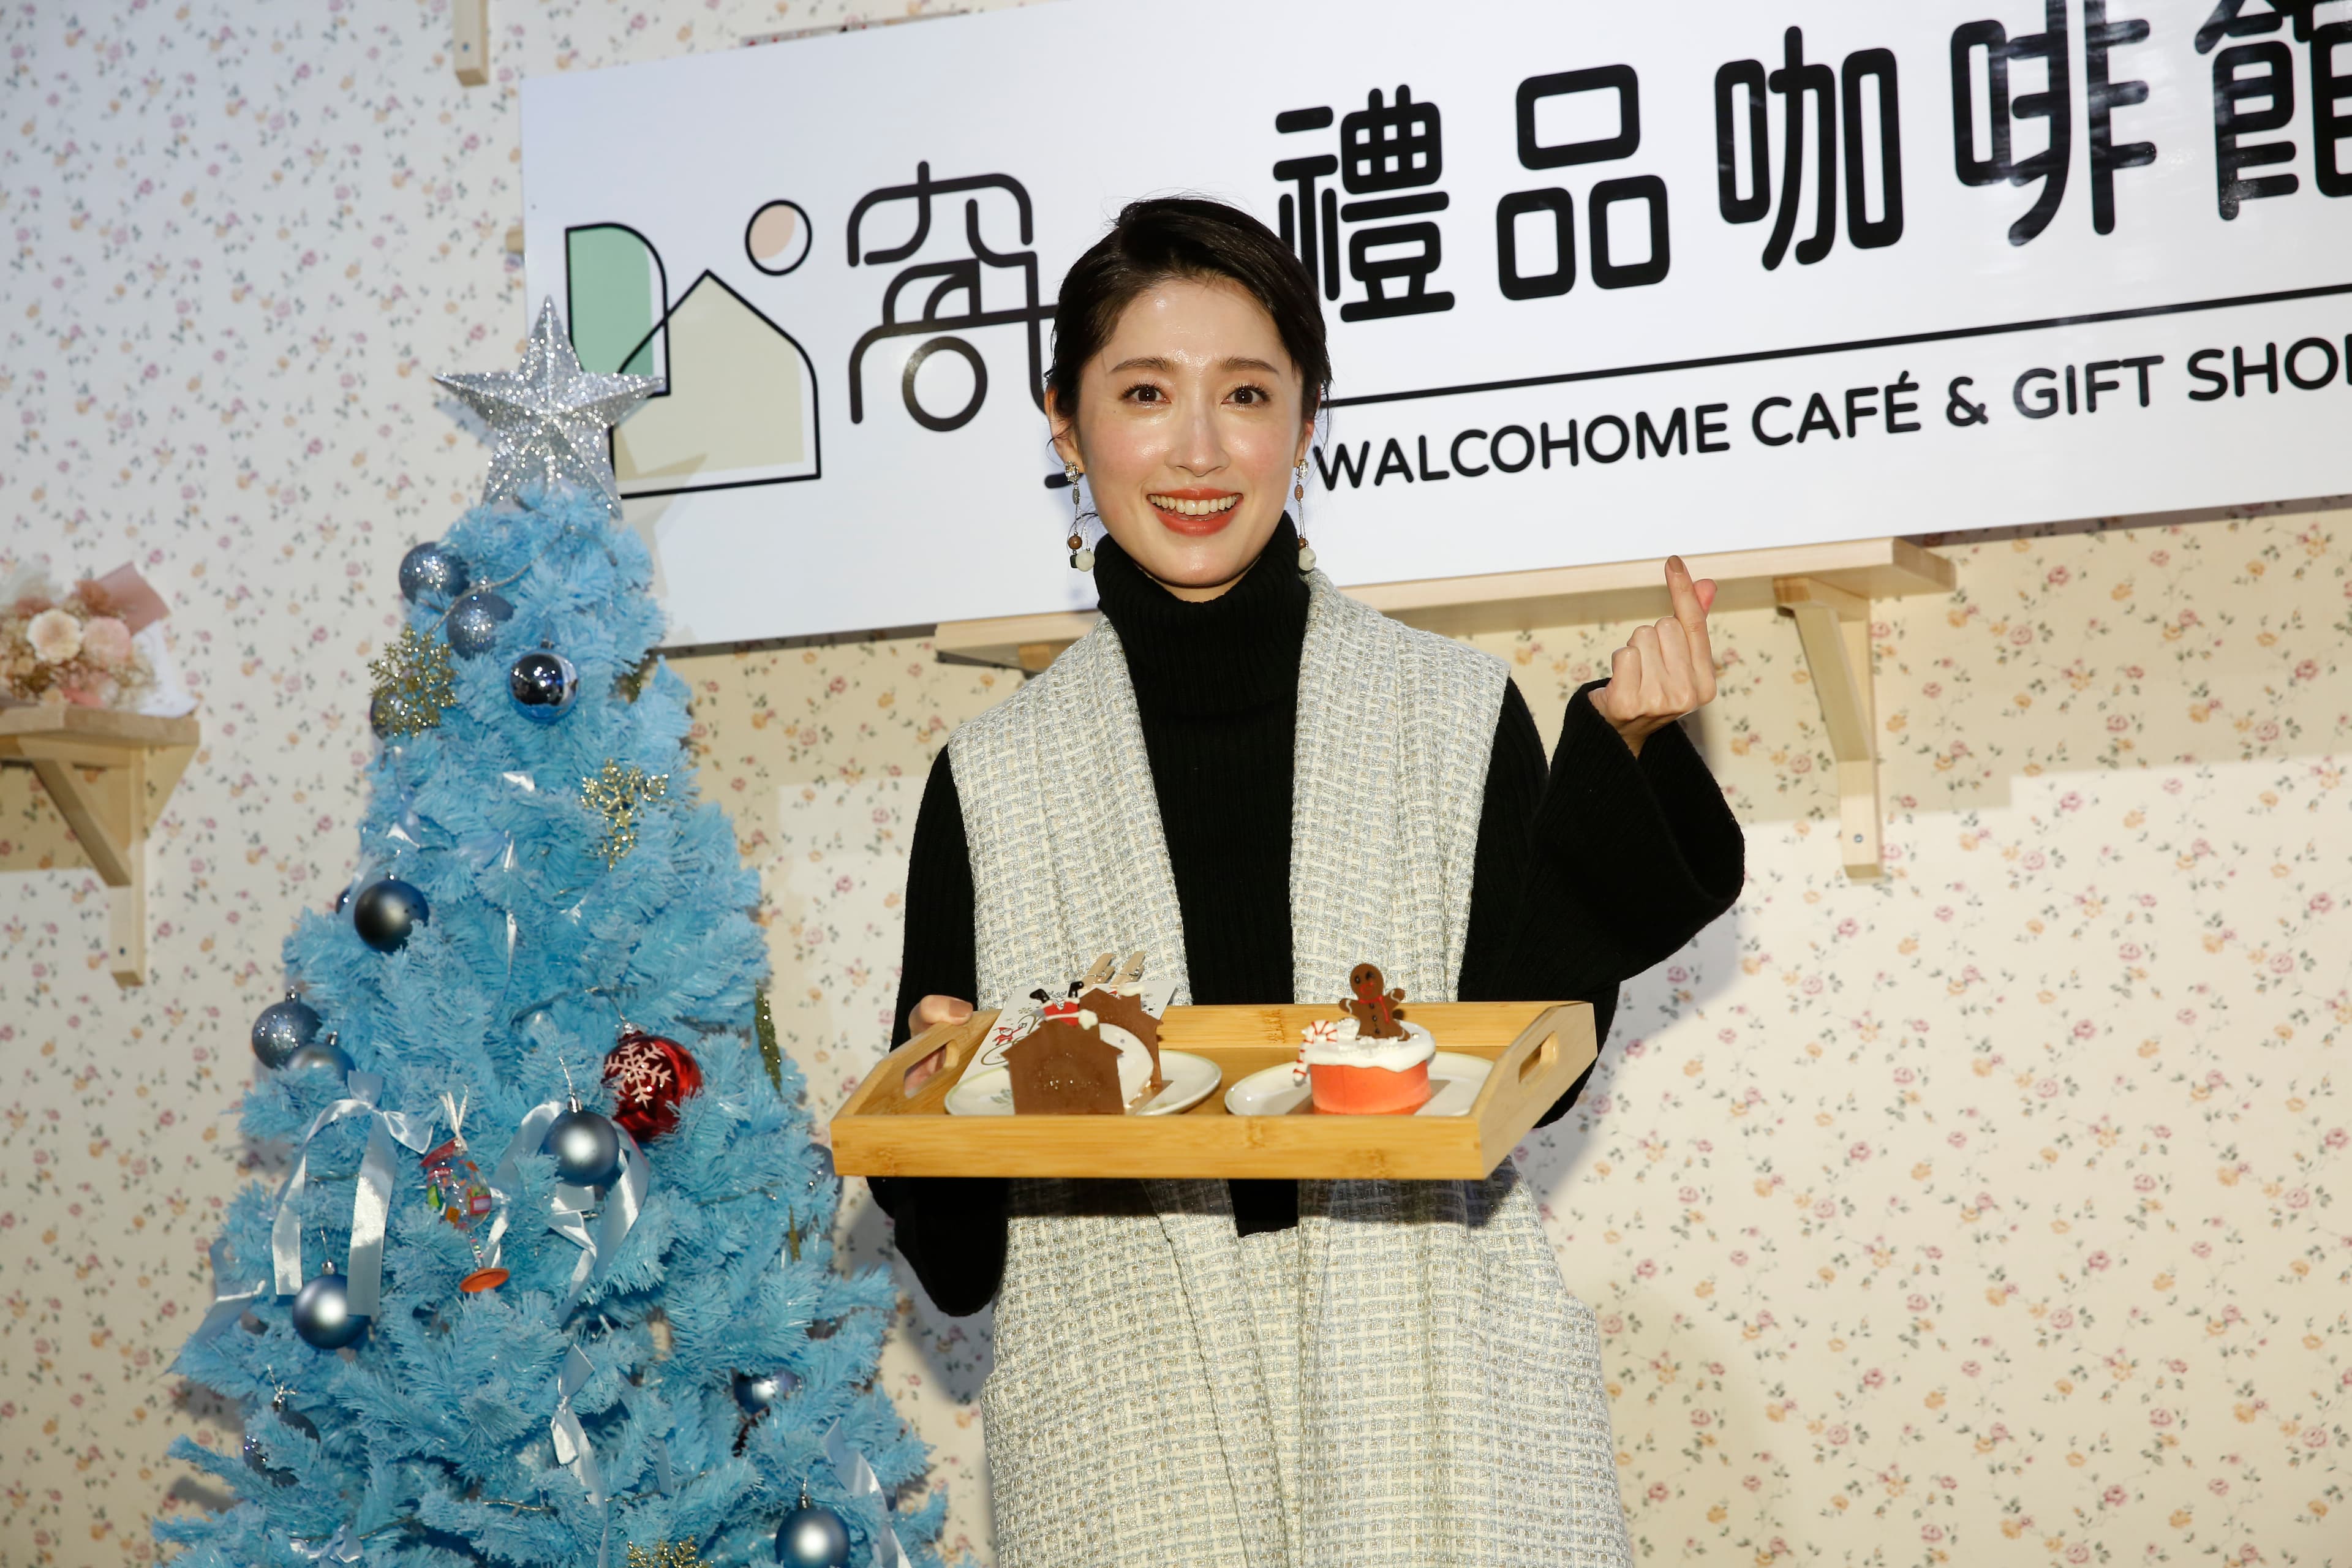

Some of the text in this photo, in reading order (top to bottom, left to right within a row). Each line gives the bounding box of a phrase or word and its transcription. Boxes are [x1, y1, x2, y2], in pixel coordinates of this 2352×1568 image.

[1313, 334, 2352, 491] WALCOHOME CAFÉ & GIFT SHO
